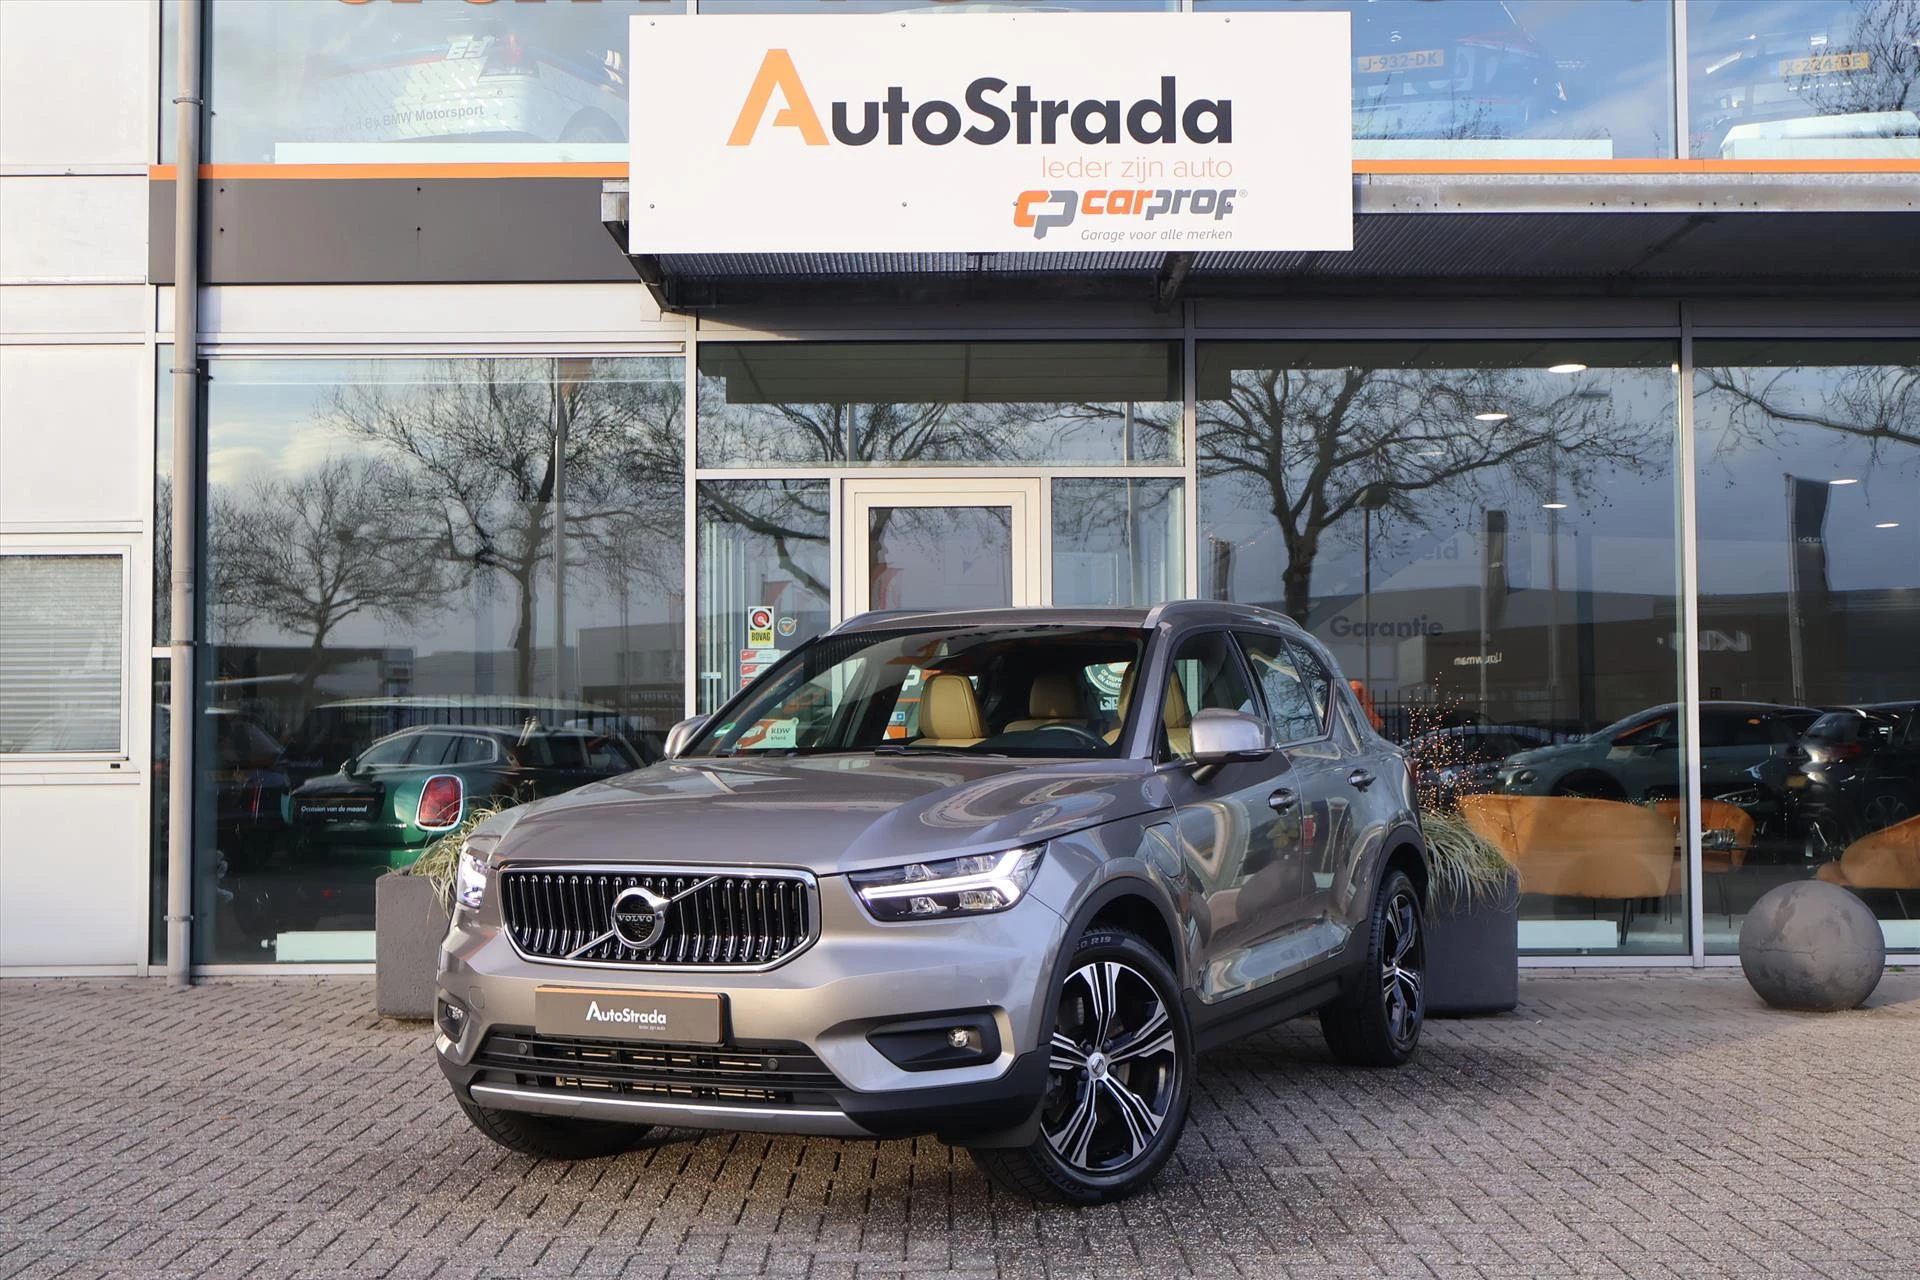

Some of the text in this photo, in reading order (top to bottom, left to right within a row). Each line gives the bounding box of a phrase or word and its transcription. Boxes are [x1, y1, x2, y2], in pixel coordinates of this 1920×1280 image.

[1363, 51, 1438, 71] J-932-DK
[726, 48, 1232, 146] AutoStrada
[383, 111, 412, 127] BMW
[415, 104, 485, 122] Motorsport
[1042, 157, 1233, 184] Ieder zijn auto
[1080, 228, 1233, 243] Garage voor alle merken
[751, 632, 771, 641] BOVAG
[1330, 615, 1444, 637] Garantie
[301, 804, 326, 813] Occasion
[338, 804, 346, 812] de
[346, 804, 367, 812] maand
[617, 914, 653, 922] VOLVO
[586, 1001, 667, 1025] AutoStrada
